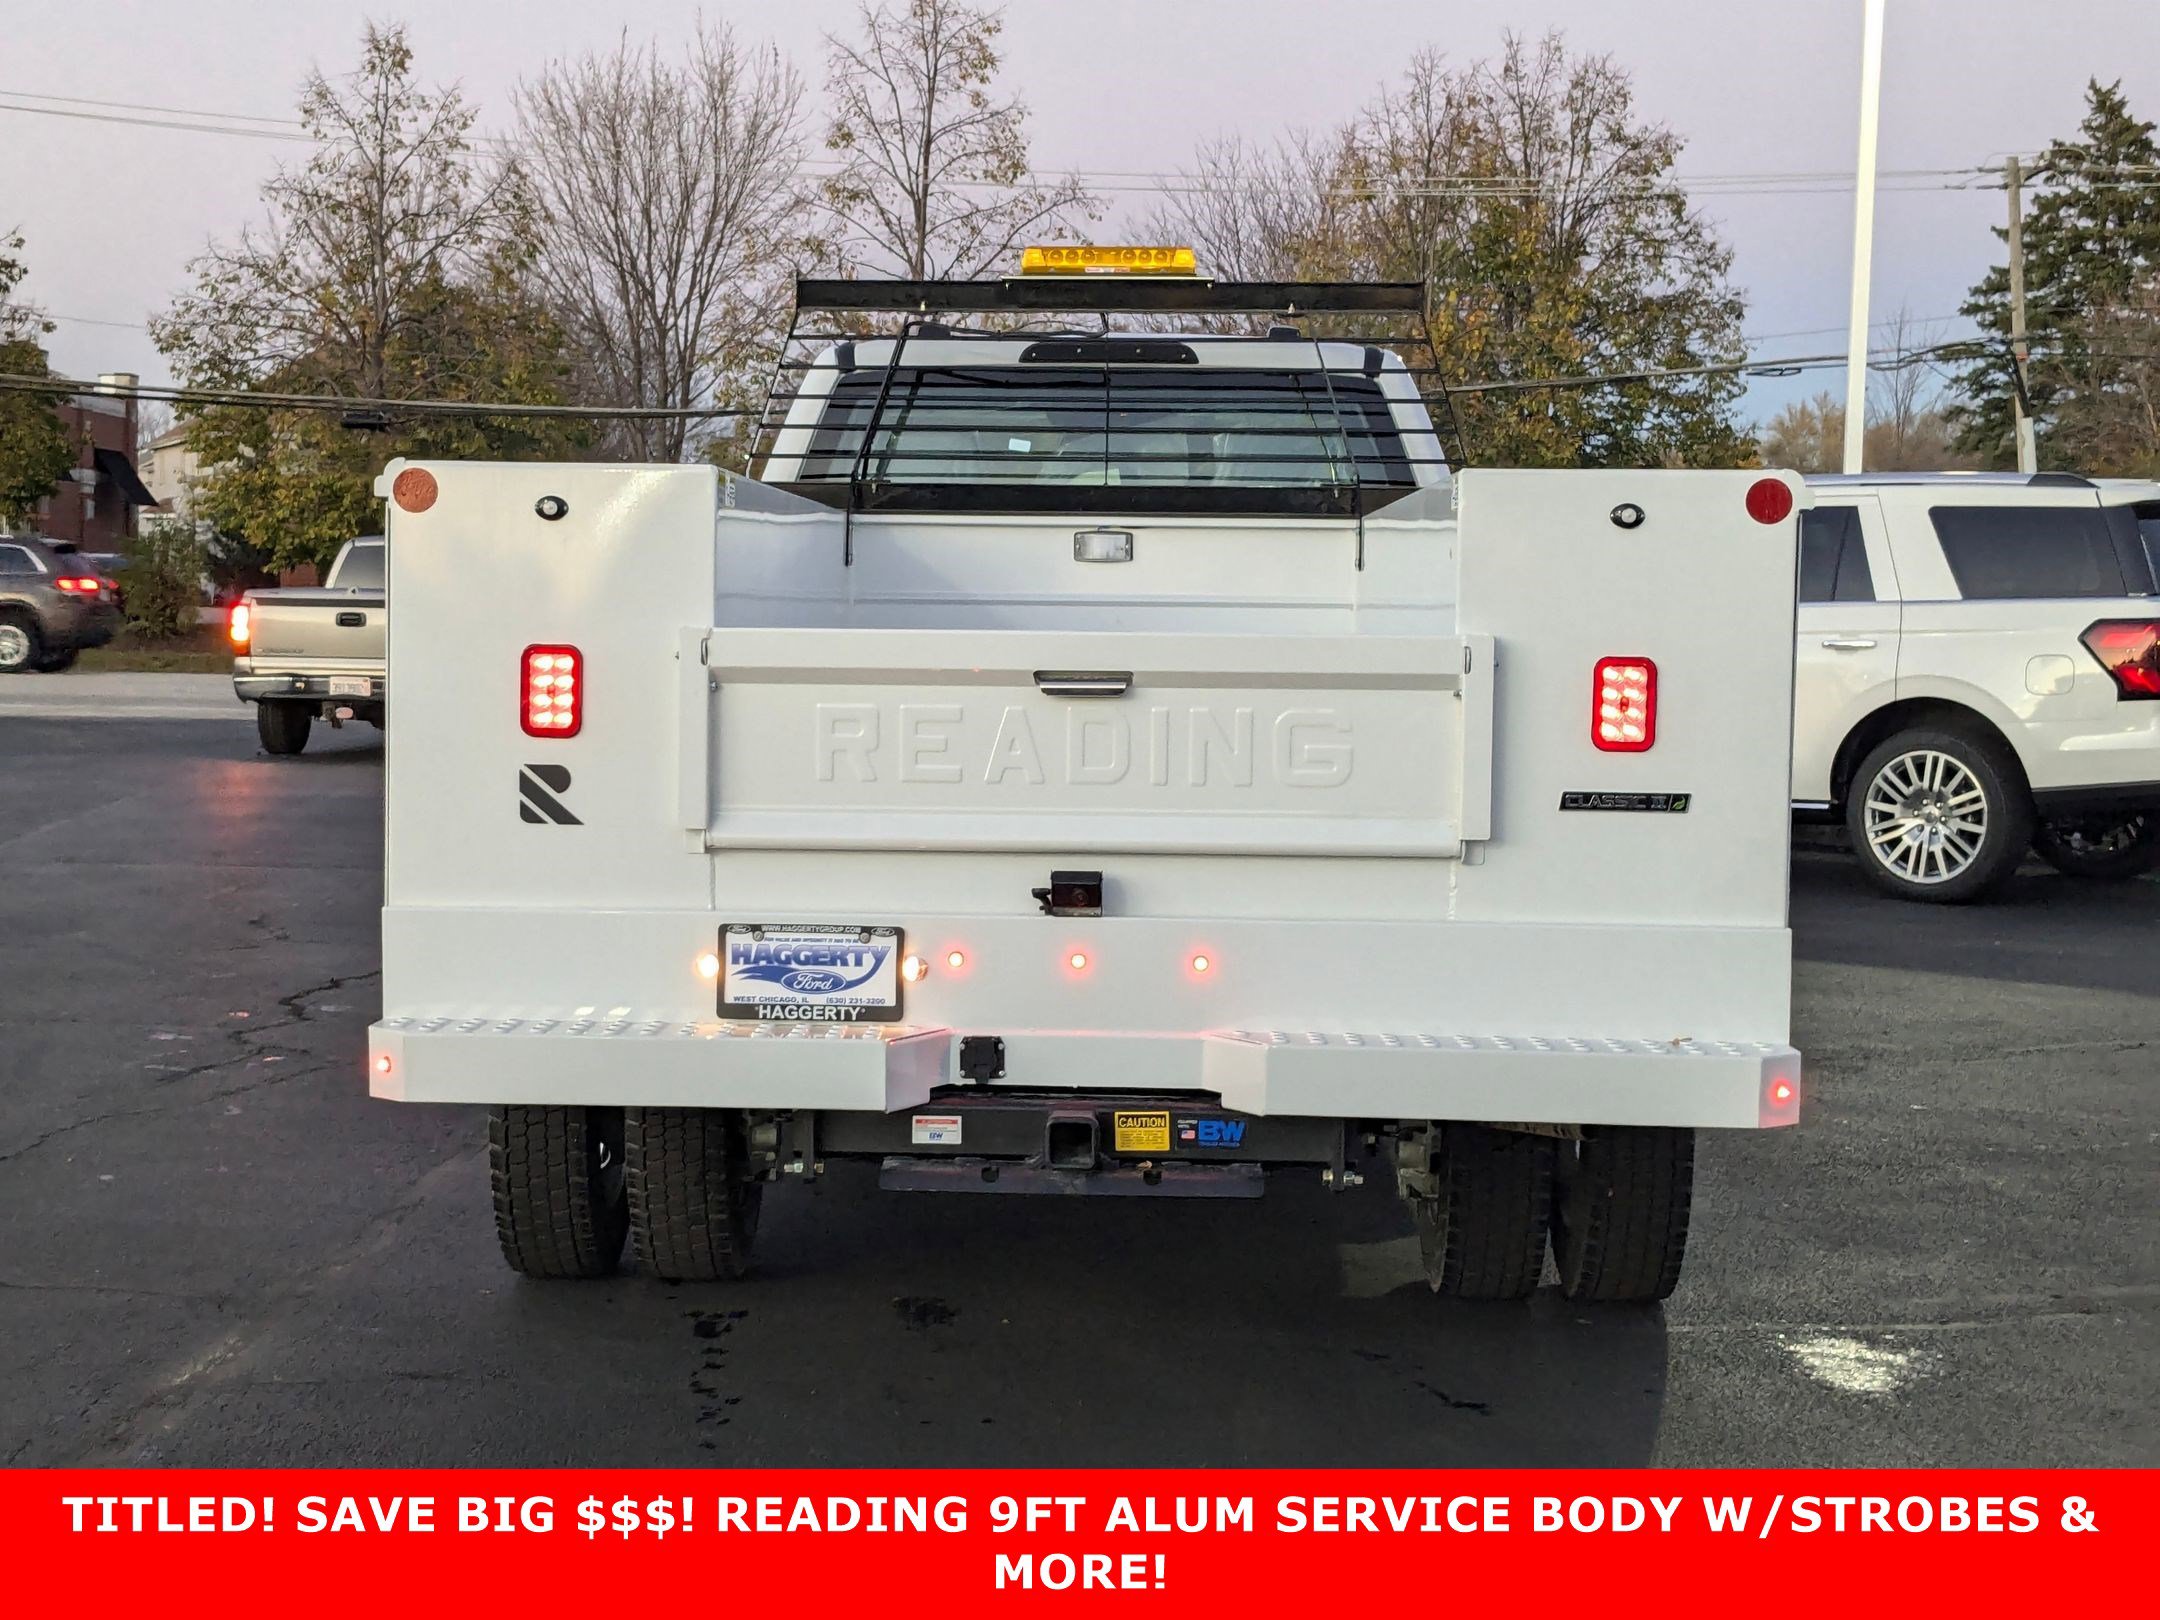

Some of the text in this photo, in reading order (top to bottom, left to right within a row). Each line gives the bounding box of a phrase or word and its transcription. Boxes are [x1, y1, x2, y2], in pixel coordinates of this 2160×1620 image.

[815, 702, 1355, 788] READING
[1564, 794, 1647, 808] CLASSIC
[761, 925, 861, 934] WWW.HAGGERTYGROUP.COM
[731, 944, 891, 968] HAGGERTY
[792, 973, 834, 990] Ford
[758, 996, 799, 1004] CHICAGO,
[826, 997, 846, 1005] (630)
[758, 1005, 860, 1021] HAGGERTY
[1118, 1117, 1165, 1128] CAUTION
